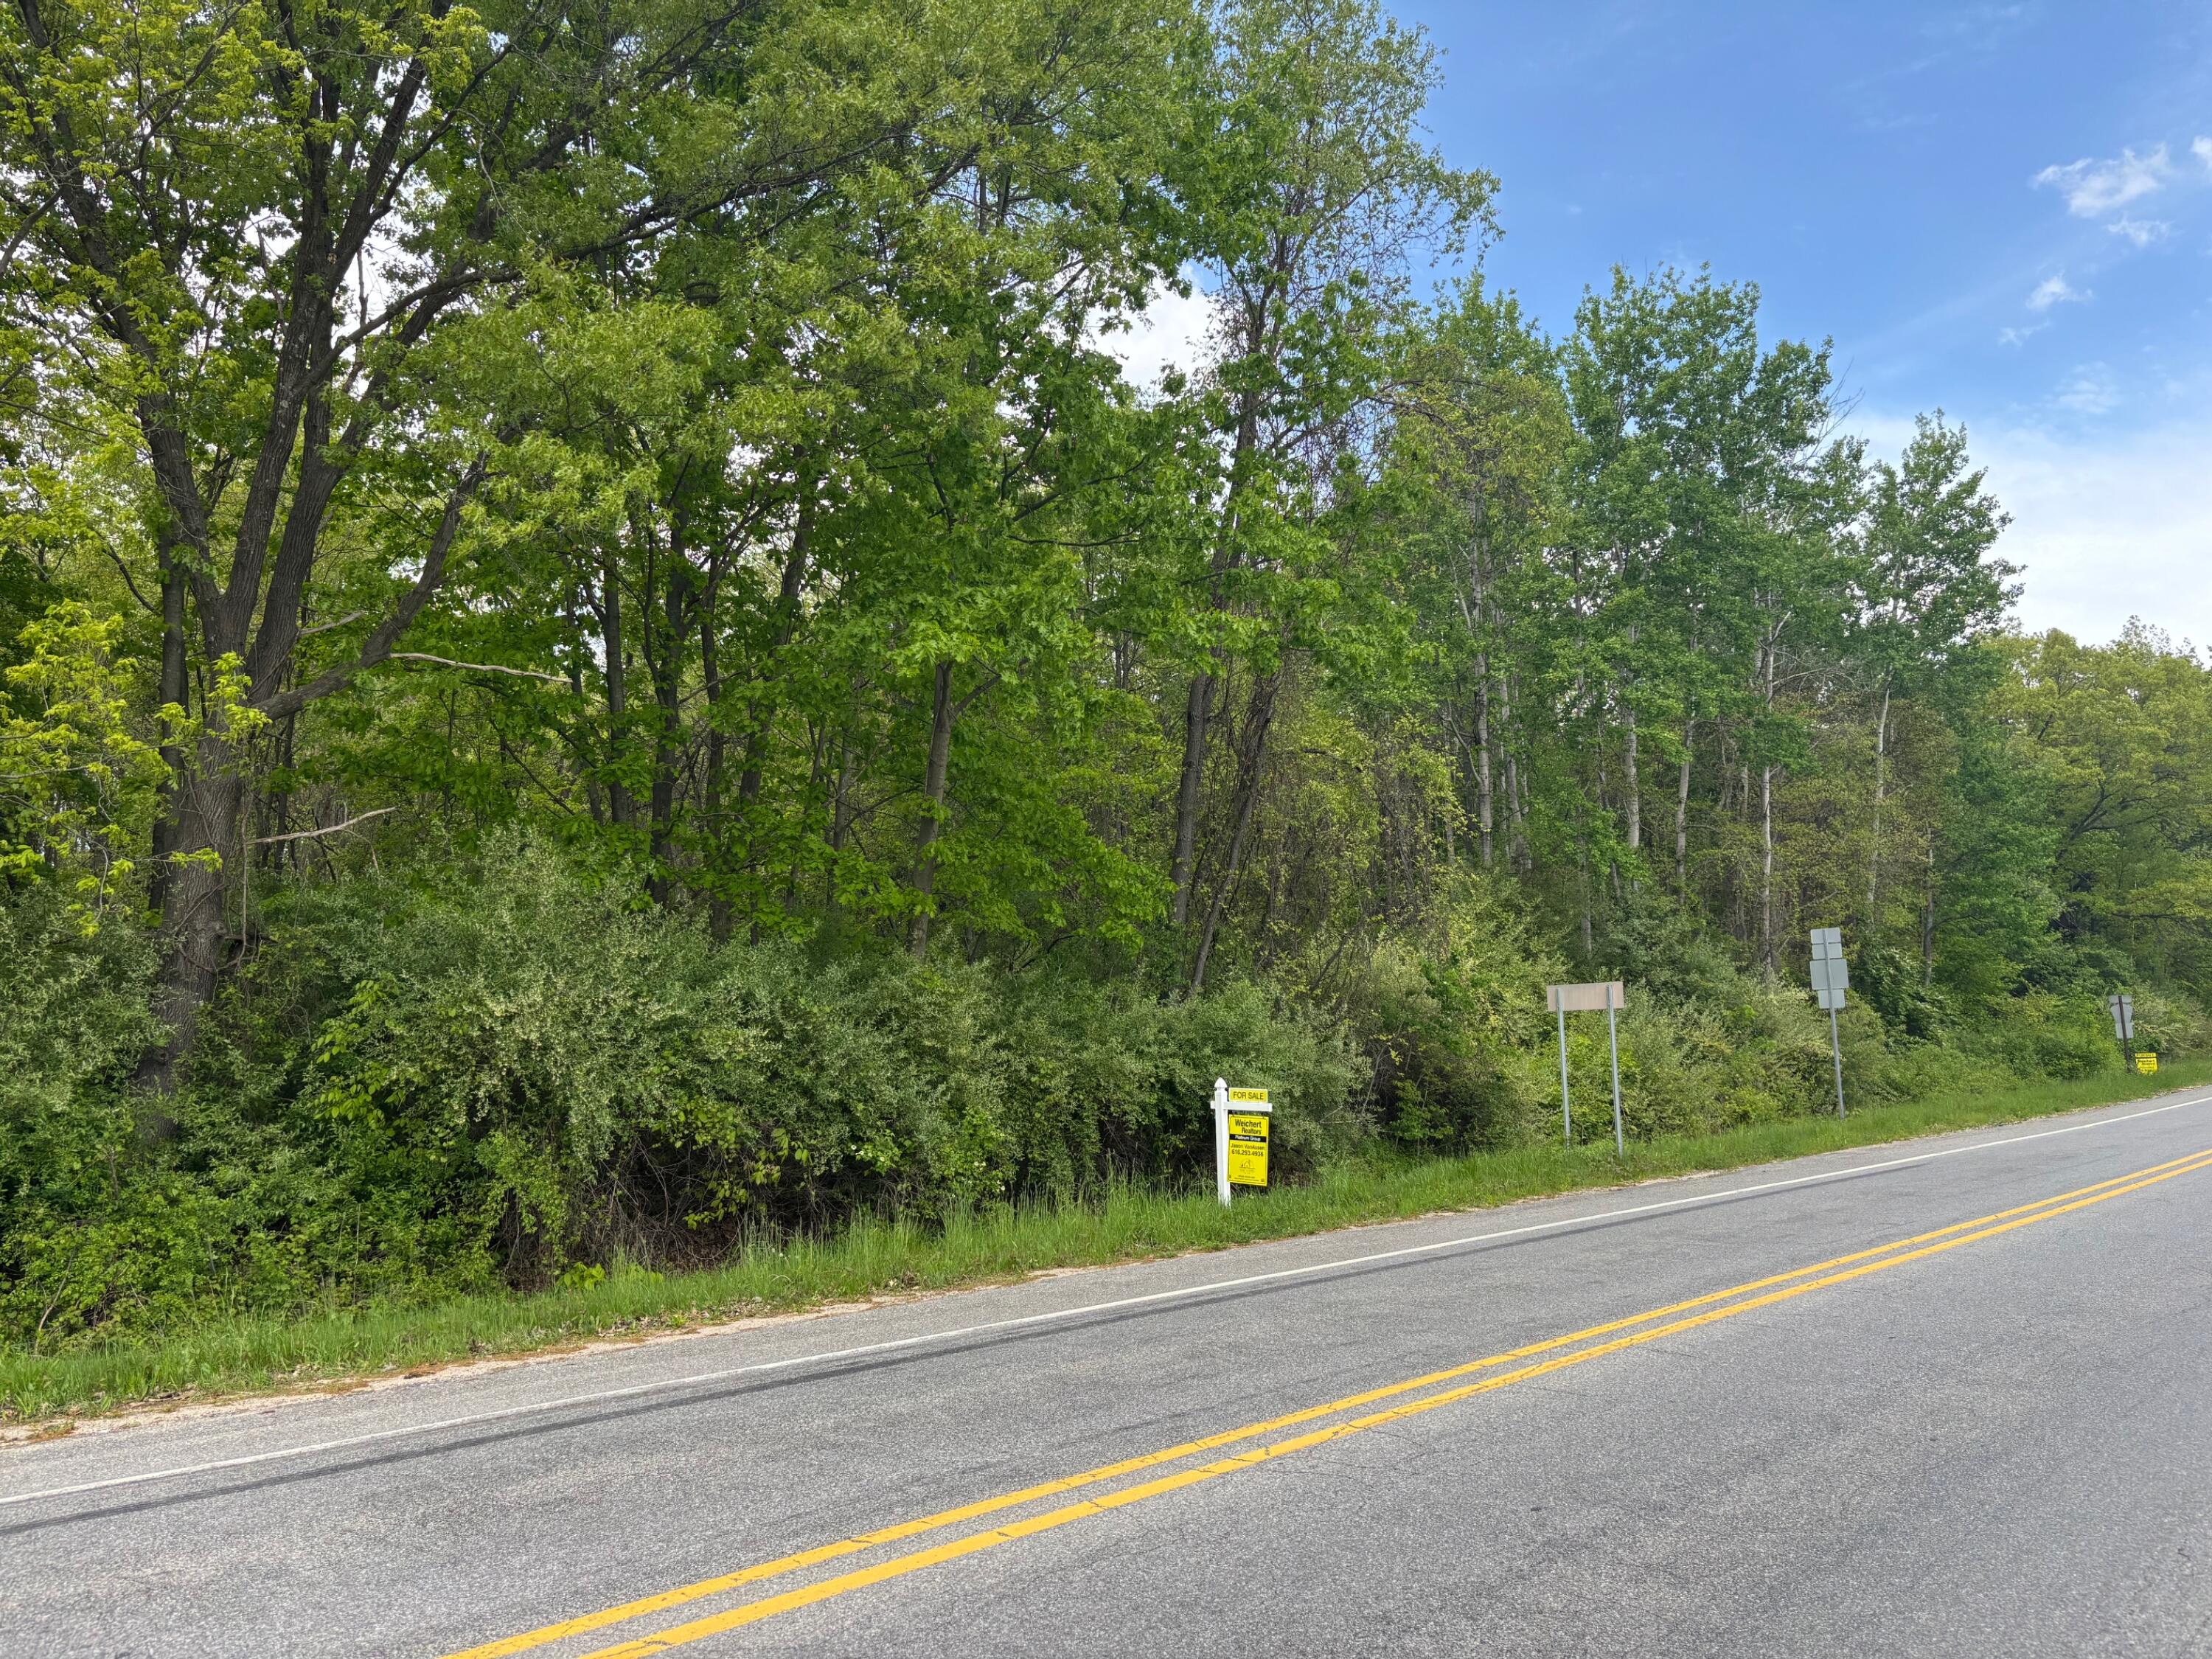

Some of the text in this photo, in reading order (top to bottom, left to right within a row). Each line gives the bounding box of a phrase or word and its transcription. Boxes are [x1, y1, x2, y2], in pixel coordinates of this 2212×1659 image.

[1233, 1091, 1264, 1100] FOR SALE
[1236, 1119, 1262, 1128] Weichert
